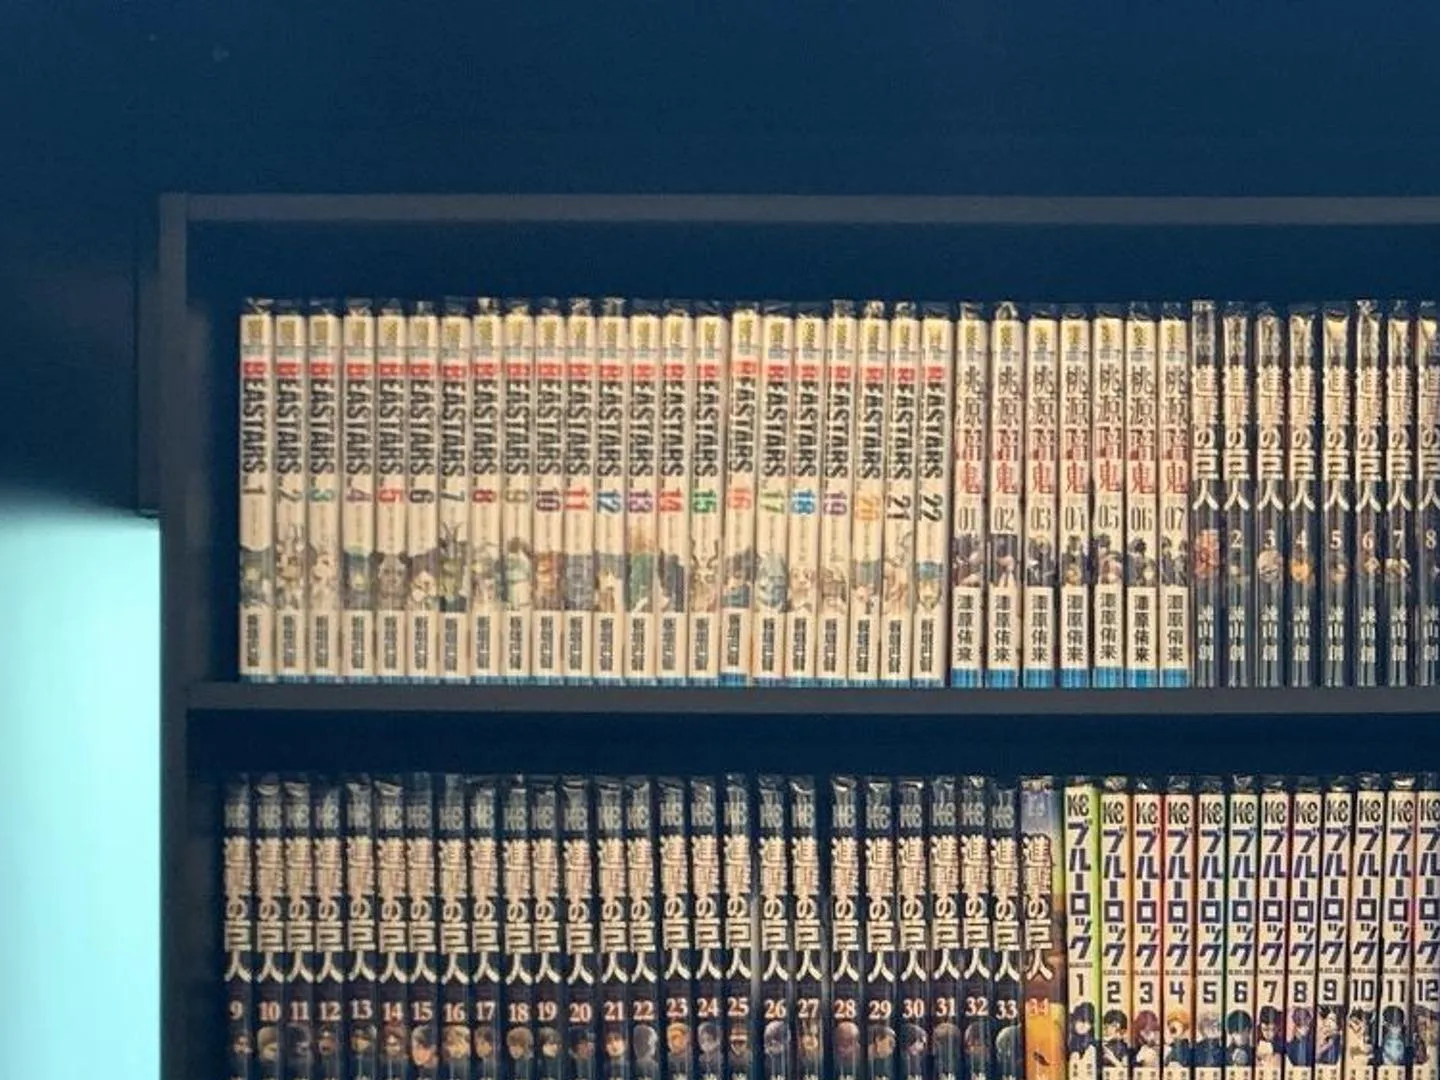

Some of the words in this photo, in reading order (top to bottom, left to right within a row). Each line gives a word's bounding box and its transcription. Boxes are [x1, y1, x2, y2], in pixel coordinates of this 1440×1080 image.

[244, 362, 267, 473] BEASTARS
[310, 362, 335, 473] BEASTARS
[410, 363, 435, 474] BEASTARS
[473, 364, 497, 475] BEASTARS
[597, 364, 622, 476] BEASTARS
[918, 366, 946, 480] BEASTARS
[1223, 365, 1249, 511] 進撃の巨人
[1356, 365, 1381, 512] 進撃の巨人
[958, 507, 977, 530] 01
[1099, 504, 1120, 528] 05
[1165, 507, 1185, 530] 07
[1230, 530, 1243, 548] 2
[1363, 530, 1374, 548] 6
[1426, 530, 1437, 549] 8
[257, 838, 284, 983] 進撃の巨人
[439, 838, 469, 984] 進撃の巨人
[832, 837, 859, 982] 進撃の巨人
[961, 834, 990, 980] 進撃の巨人
[1068, 819, 1093, 960] ブルーロック
[1103, 827, 1127, 967] ブルーロック
[1230, 827, 1257, 967] ブルーロック
[1353, 825, 1383, 965] ブルーロック
[260, 1002, 281, 1021] 10
[443, 1002, 465, 1022] 16
[834, 1000, 856, 1018] 28
[966, 997, 988, 1016] 32
[1076, 974, 1084, 996] 1
[1107, 981, 1120, 1003] 2
[1234, 981, 1248, 1003] 6
[1352, 979, 1374, 1001] 10
[1417, 979, 1440, 1001] 12
